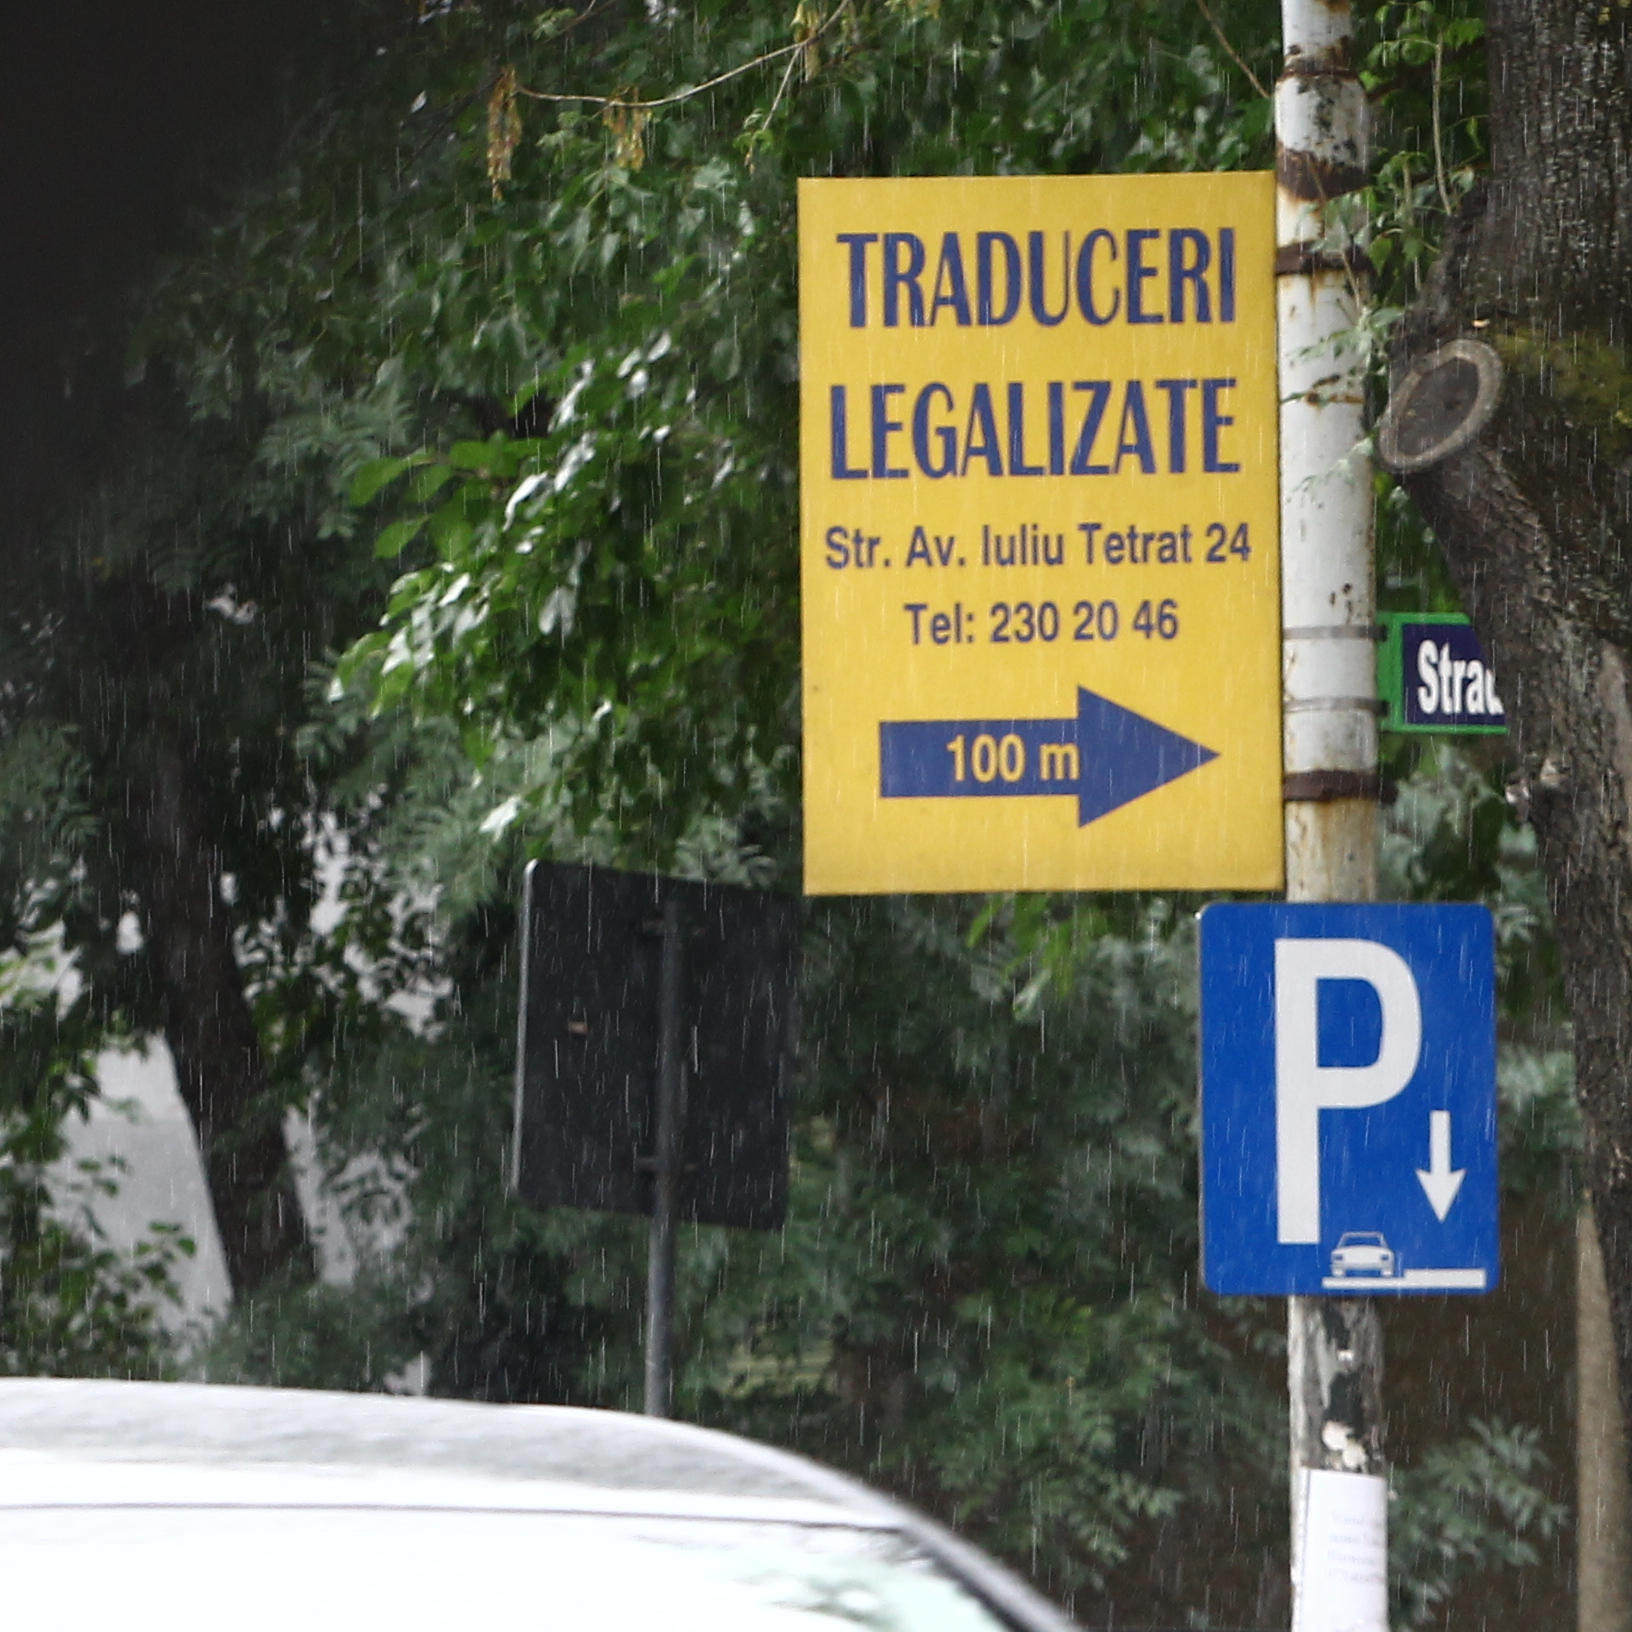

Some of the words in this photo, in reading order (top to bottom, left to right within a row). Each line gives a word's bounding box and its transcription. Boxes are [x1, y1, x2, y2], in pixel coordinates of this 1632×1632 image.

[836, 227, 1237, 328] TRADUCERI
[829, 378, 1240, 480] LEGALIZATE
[825, 526, 890, 569] Str.
[906, 527, 965, 567] Av.
[982, 524, 1064, 566] Iuliu
[1078, 524, 1193, 565] Tetrat
[1205, 522, 1252, 563] 24
[905, 603, 975, 645] Tel:
[990, 602, 1060, 643] 230
[1074, 601, 1119, 641] 20
[1132, 599, 1179, 639] 46
[946, 734, 1026, 783] 100
[1039, 742, 1080, 780] m
[1274, 937, 1422, 1245] P
